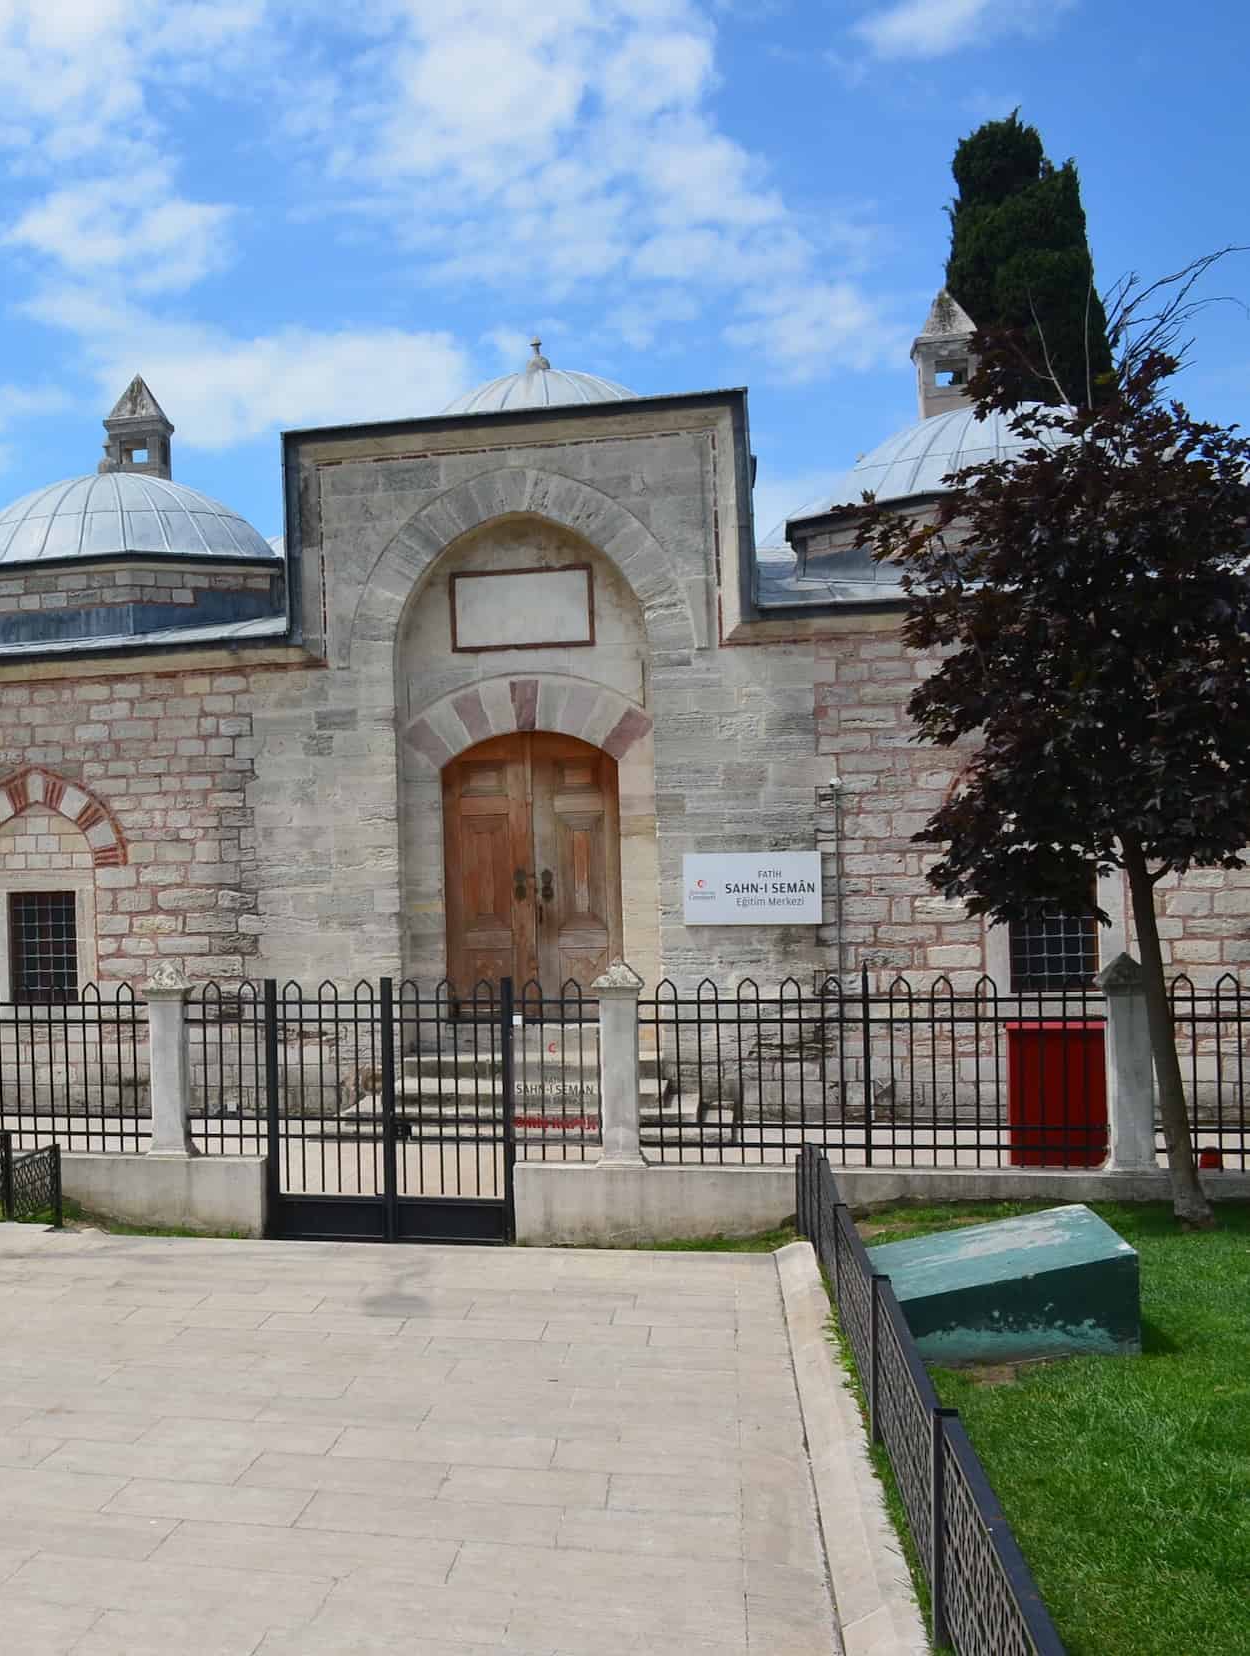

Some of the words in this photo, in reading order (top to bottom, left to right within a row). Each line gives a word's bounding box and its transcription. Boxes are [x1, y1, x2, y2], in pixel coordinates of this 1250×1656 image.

[758, 869, 782, 878] FATİH
[725, 882, 768, 894] SAHN-I
[773, 879, 815, 893] SEMÂN
[736, 897, 766, 907] Eğitim
[768, 897, 804, 906] Merkezi
